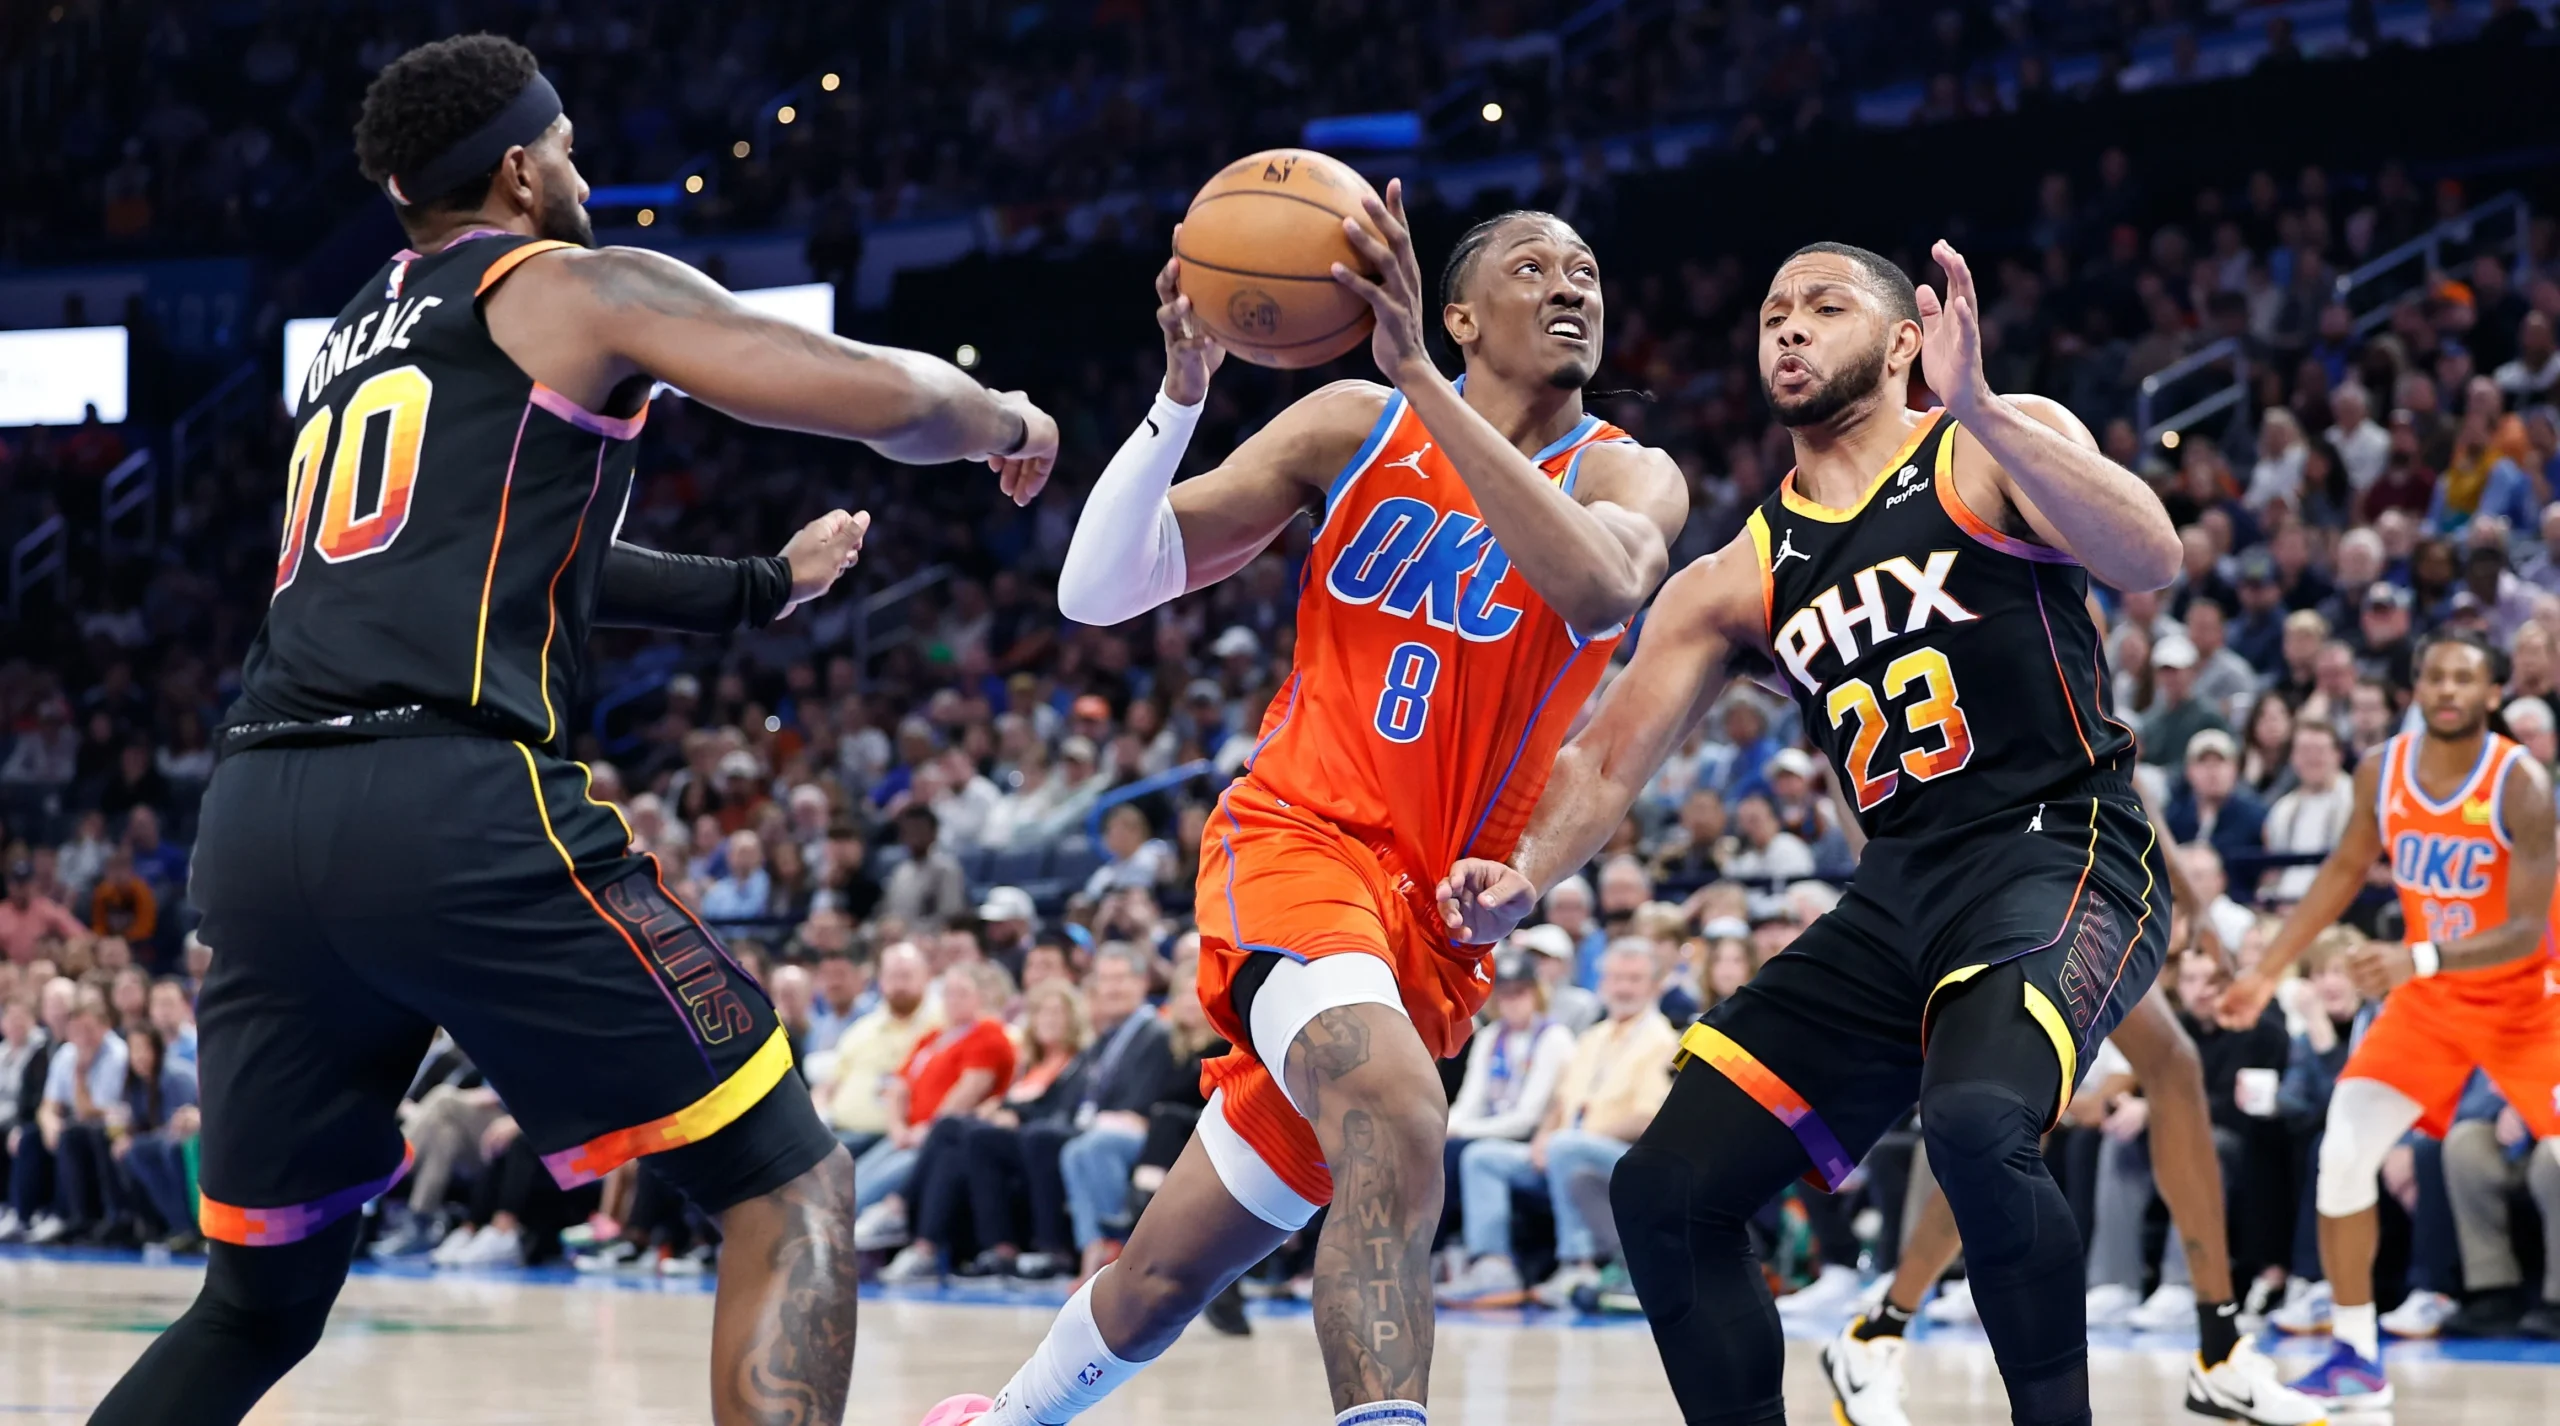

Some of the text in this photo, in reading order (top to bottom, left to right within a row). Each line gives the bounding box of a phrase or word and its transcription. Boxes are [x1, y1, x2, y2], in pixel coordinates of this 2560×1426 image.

[270, 364, 433, 608] 00
[1886, 477, 1929, 509] PayPal
[1325, 496, 1524, 643] OKC
[1774, 549, 1982, 696] PHX
[1373, 641, 1441, 744] 8
[1826, 646, 1975, 813] 23
[2392, 831, 2498, 900] OKC
[604, 872, 753, 1045] SUNS
